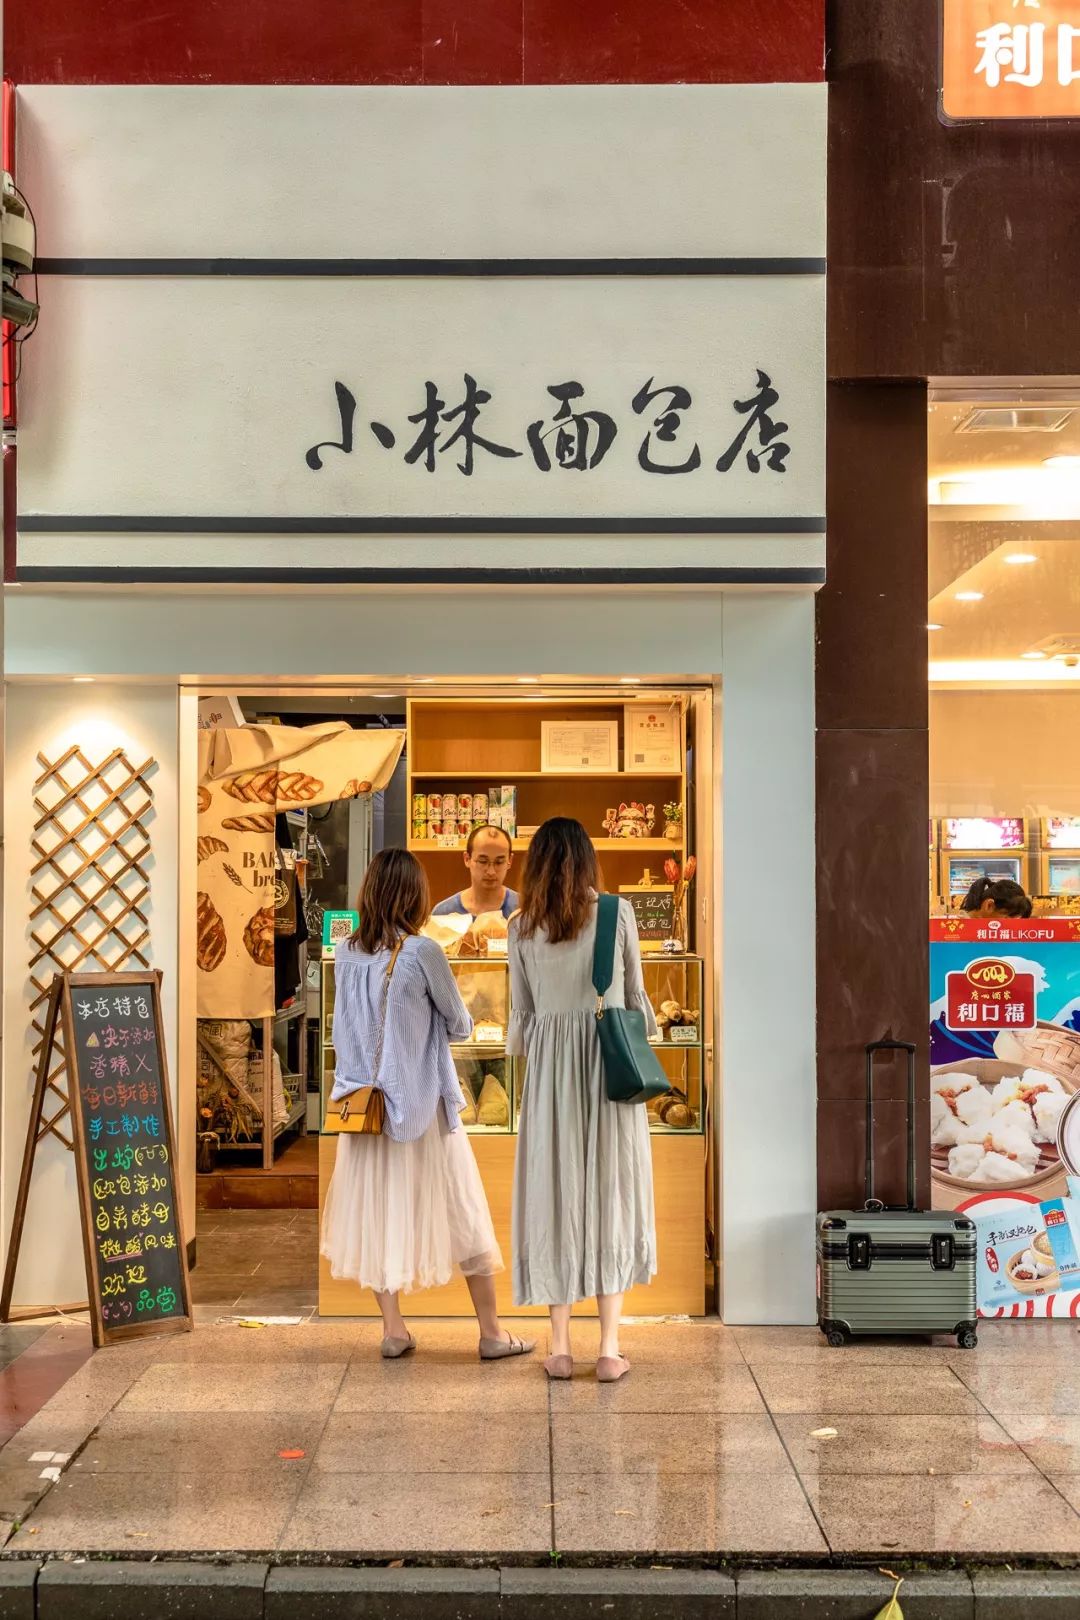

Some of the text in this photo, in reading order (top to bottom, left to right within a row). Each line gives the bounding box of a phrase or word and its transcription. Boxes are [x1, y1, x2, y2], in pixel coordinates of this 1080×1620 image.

[305, 368, 791, 476] 小林面包店
[977, 928, 1055, 940] 利口福 LIKOFU
[77, 996, 149, 1020] 本店特色
[957, 1003, 1025, 1023] 利口福
[89, 1114, 160, 1140] 手工制作
[93, 1173, 167, 1199] 欧包添加
[96, 1202, 170, 1231] 自养酵母
[101, 1265, 148, 1296] 欢迎
